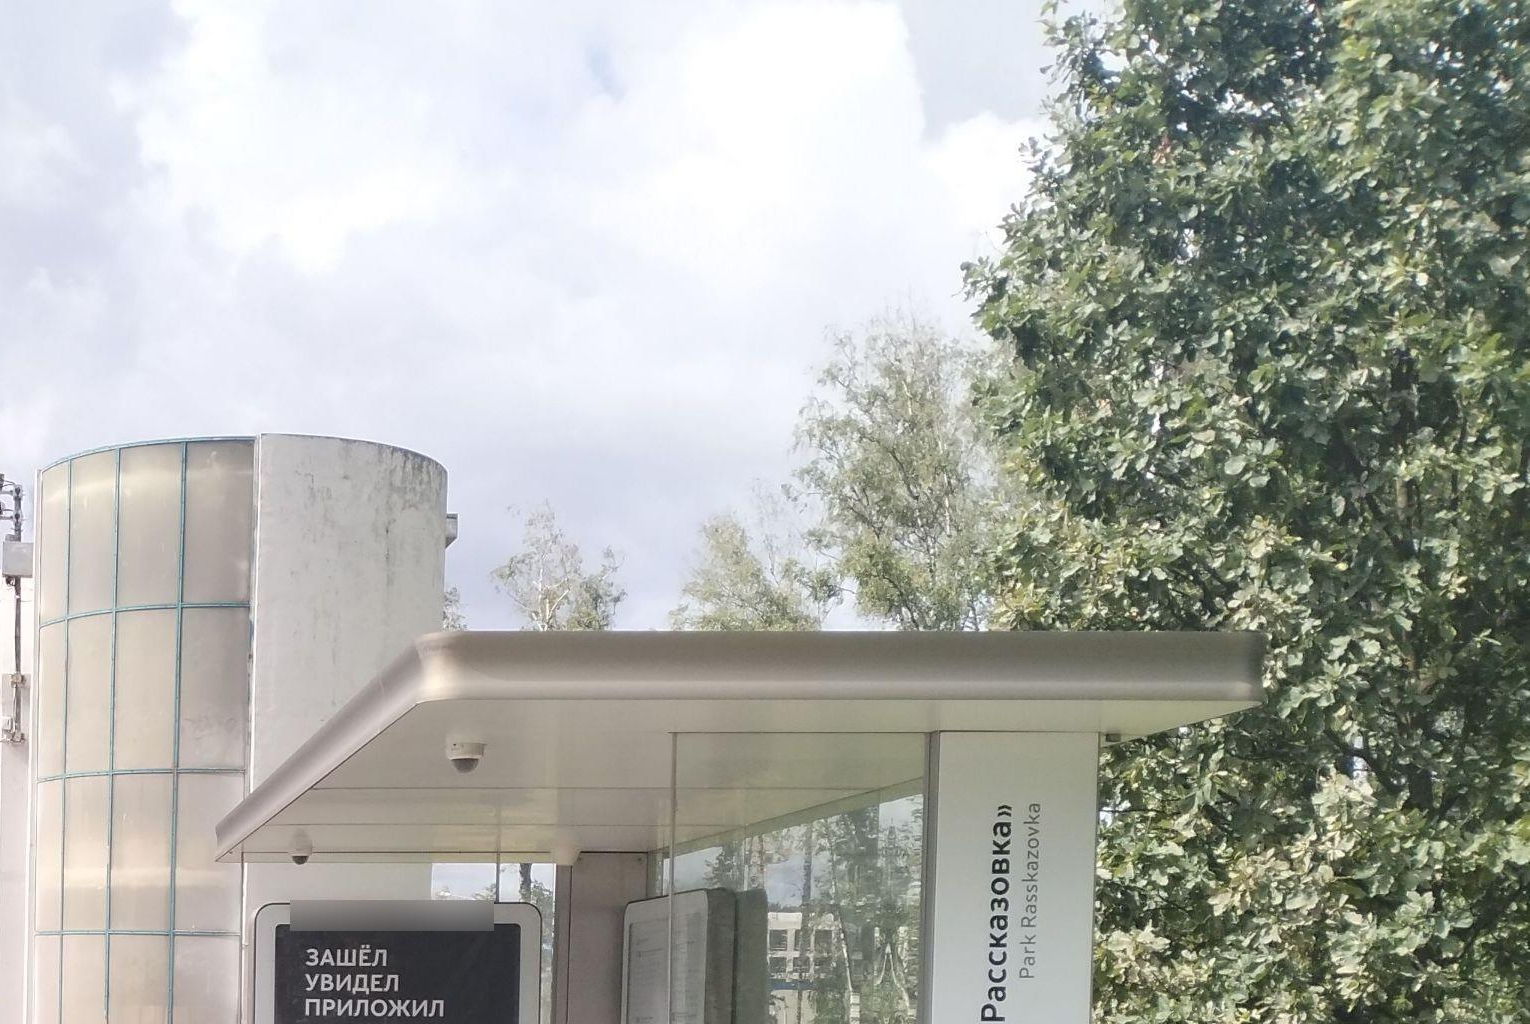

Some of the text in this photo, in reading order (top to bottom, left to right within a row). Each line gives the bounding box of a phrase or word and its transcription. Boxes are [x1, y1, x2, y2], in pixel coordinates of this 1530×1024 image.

[1018, 802, 1042, 980] Park Rasskazovka
[304, 944, 388, 967] ЗАШЁЛ
[304, 973, 400, 995] УВИДЕЛ
[304, 998, 445, 1018] ПРИЛОЖИЛ
